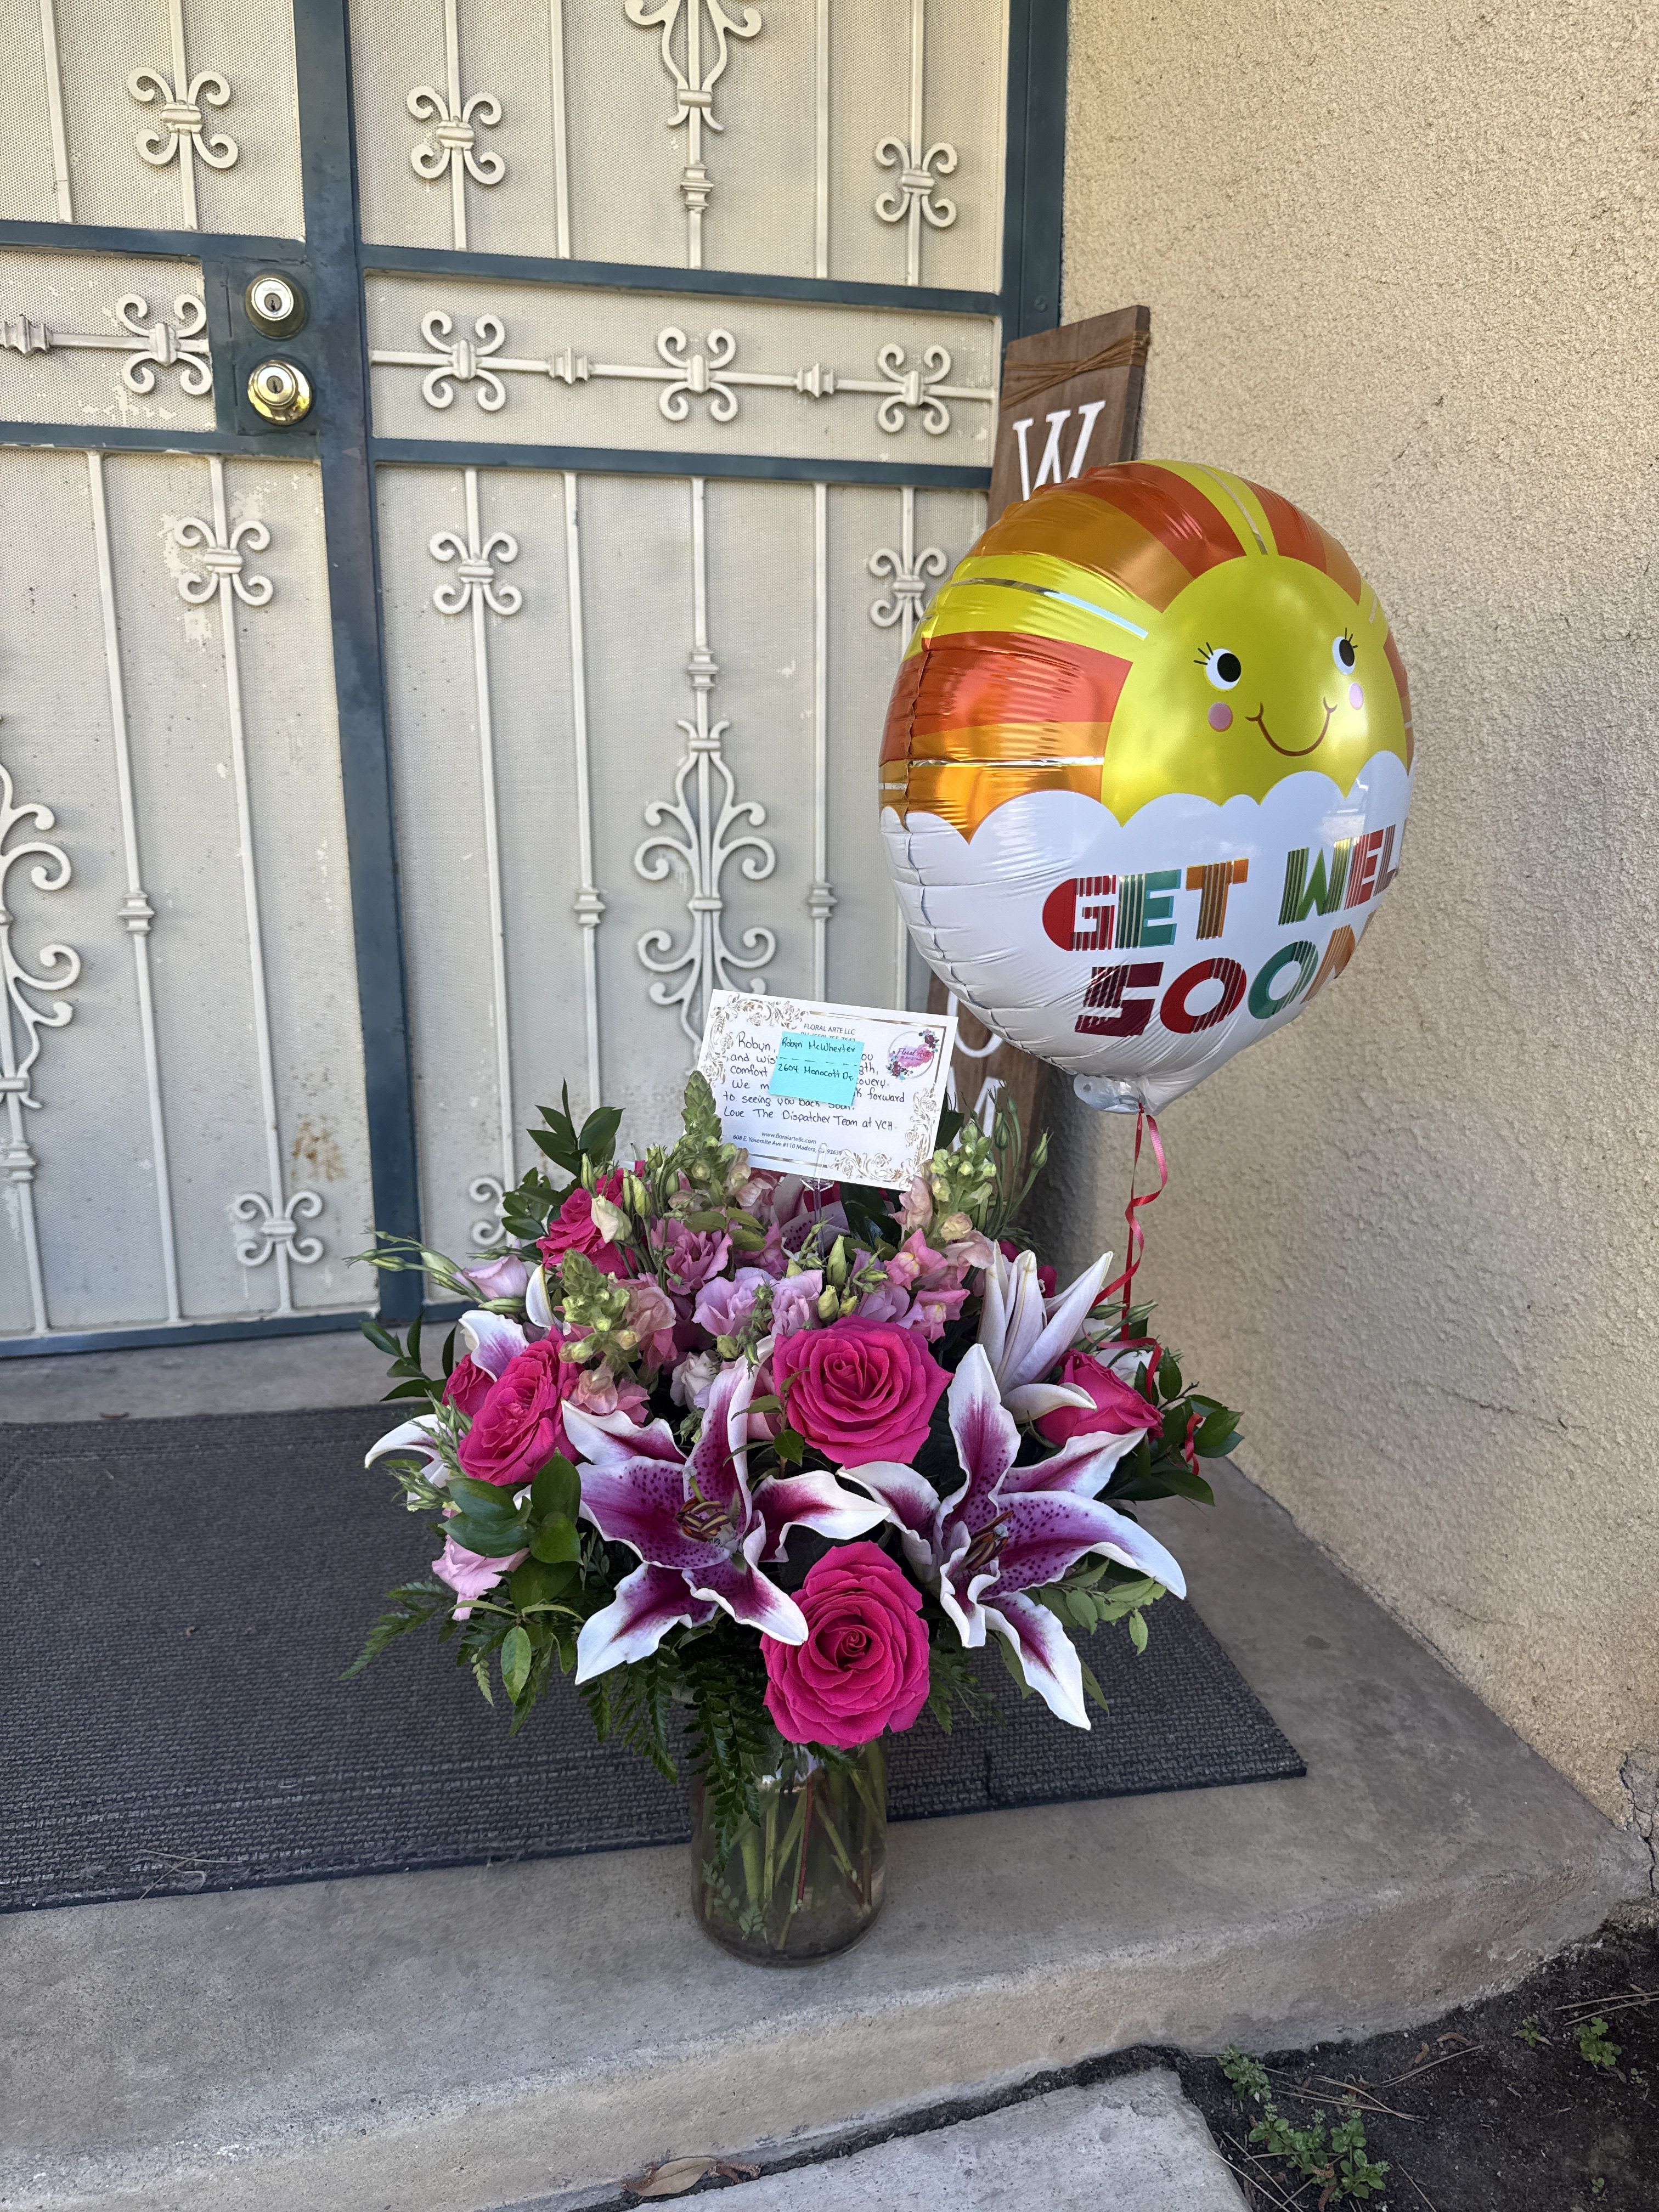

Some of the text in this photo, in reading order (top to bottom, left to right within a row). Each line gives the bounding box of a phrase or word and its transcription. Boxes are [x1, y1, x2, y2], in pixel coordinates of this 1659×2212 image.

[1042, 858, 1248, 951] GET
[804, 1023, 826, 1031] FLORAL
[782, 1037, 802, 1049] Robyn
[730, 1053, 749, 1062] and
[757, 1055, 777, 1064] wis
[778, 1064, 798, 1073] 2604
[732, 1079, 751, 1088] We
[867, 1087, 905, 1103] forward
[723, 1091, 735, 1101] to
[742, 1095, 771, 1107] seeing
[777, 1098, 794, 1106] you
[799, 1098, 820, 1107] back
[724, 1106, 744, 1118] Love
[753, 1109, 774, 1118] The
[782, 1110, 831, 1124] Dispatcher
[833, 1115, 857, 1126] Team
[862, 1116, 872, 1127] at
